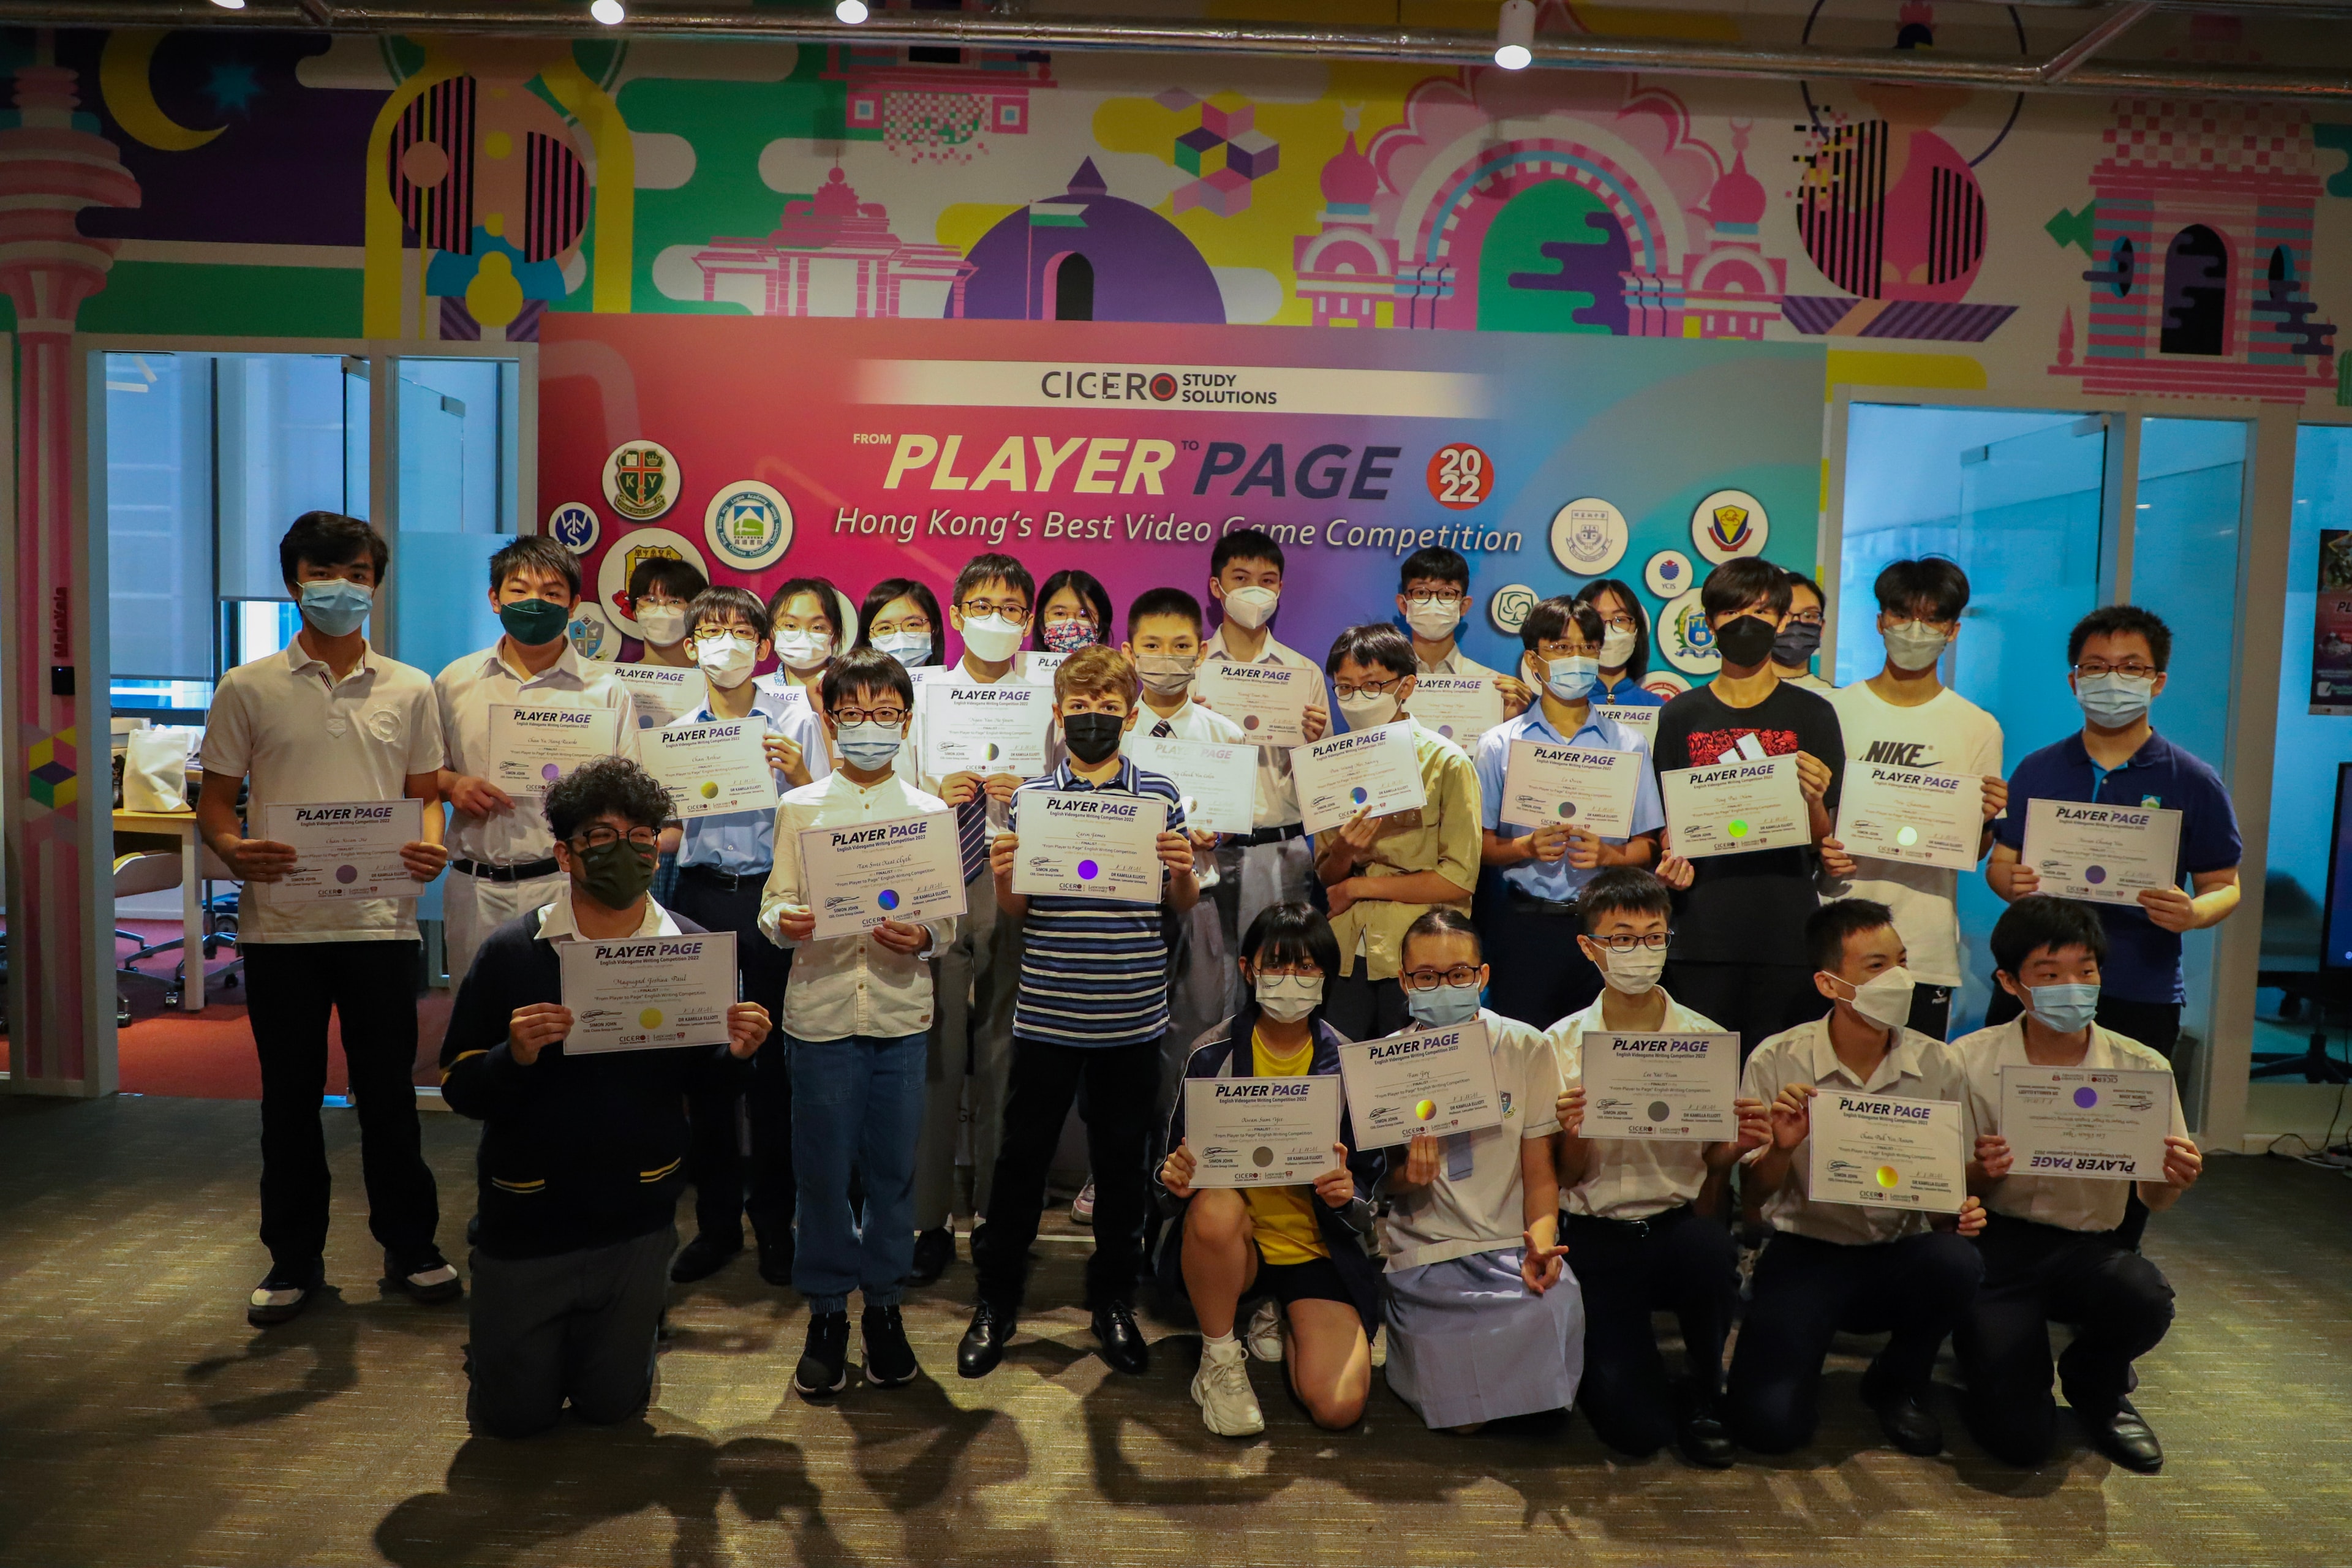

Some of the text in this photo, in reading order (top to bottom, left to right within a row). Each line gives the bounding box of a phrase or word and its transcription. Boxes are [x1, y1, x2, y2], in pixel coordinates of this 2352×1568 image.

[1041, 371, 1237, 402] CICERO STUDY
[1182, 390, 1277, 405] SOLUTIONS
[853, 434, 1402, 500] FROM PLAYER TO PAGE
[835, 508, 918, 543] Hong
[928, 509, 1033, 545] Kong's
[1044, 511, 1115, 540] Best
[1126, 513, 1211, 541] Video
[1326, 519, 1523, 556] Competition
[1038, 658, 1061, 667] PLA
[614, 668, 685, 681] PLAYER PAGE
[910, 674, 924, 682] GE
[1220, 666, 1292, 680] PLAYER PAGE
[1453, 680, 1482, 689] PAGE
[951, 690, 1031, 701] PLAYER PAGE
[513, 710, 591, 723] PLAYER PAGE
[1623, 711, 1653, 720] PAGE
[662, 725, 741, 742] PLAYER PAGE
[1312, 730, 1386, 756] PLAYER PAGE
[1200, 748, 1234, 759] PAGE
[1534, 748, 1616, 766] PLAYER PAGE
[1865, 741, 1926, 766] NIKE
[1690, 764, 1775, 784] PLAYER PAGE
[1871, 769, 1960, 789] PLAYER PAGE
[296, 807, 393, 820] PLAYER PAGE
[1046, 799, 1138, 816] PLAYER PAGE
[2056, 808, 2150, 824] PLAYER PAGE
[832, 821, 927, 846] PLAYER PAGE
[595, 942, 703, 959] PLAYER PAGE
[1370, 1032, 1459, 1059] PLAYER PAGE
[1613, 1039, 1710, 1052] PLAYER PAGE
[1215, 1084, 1310, 1096] PLAYER PAGE
[1839, 1099, 1931, 1118] PLAYER PAGE
[2029, 1156, 2135, 1172] PLAYER PAGE
